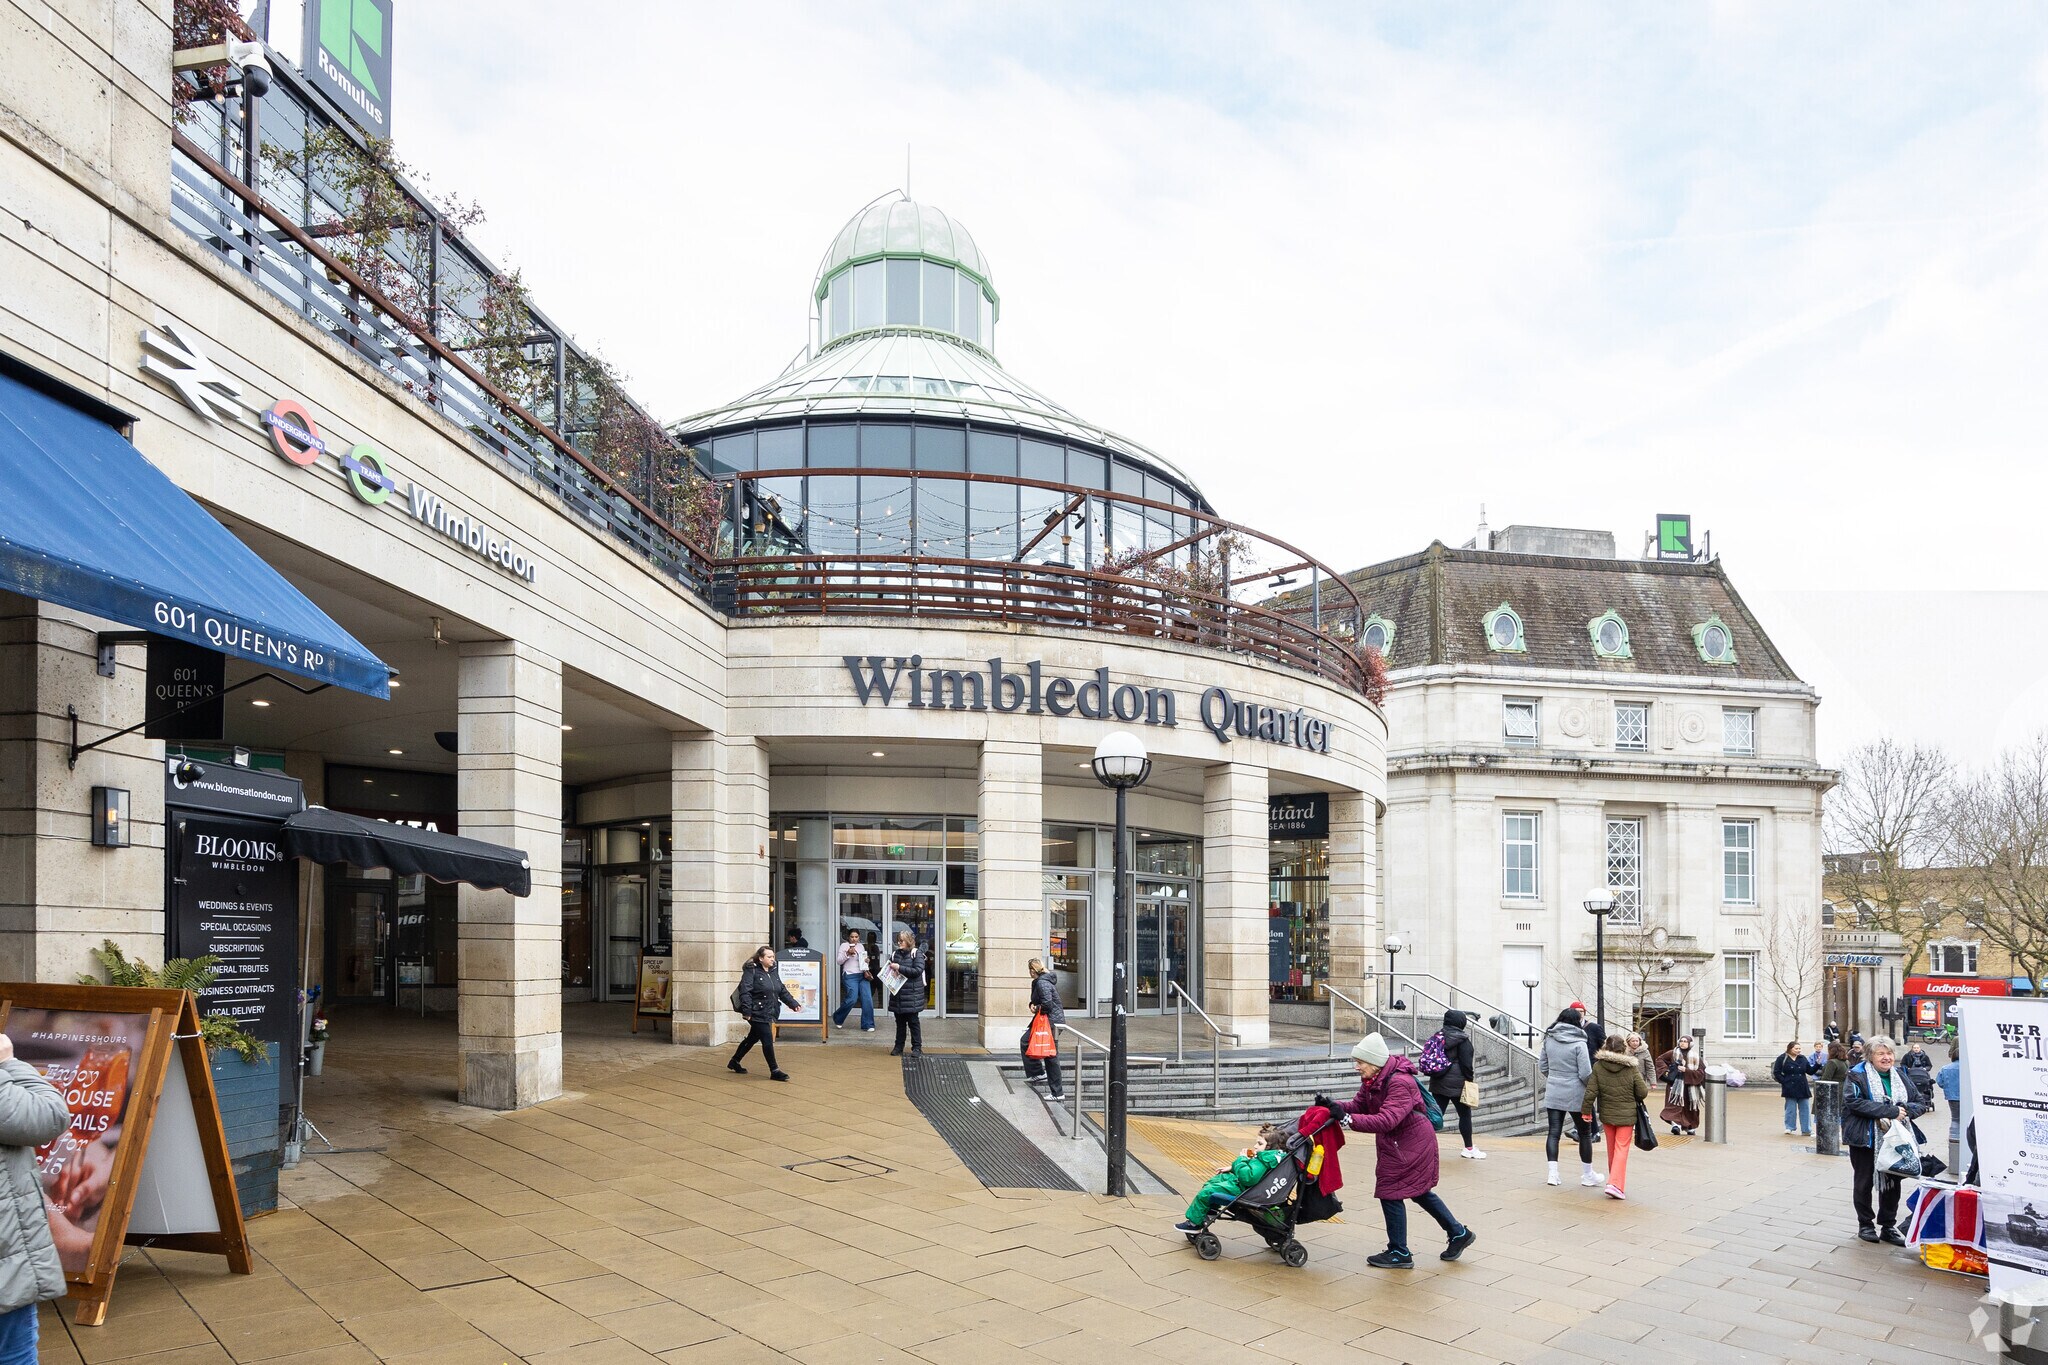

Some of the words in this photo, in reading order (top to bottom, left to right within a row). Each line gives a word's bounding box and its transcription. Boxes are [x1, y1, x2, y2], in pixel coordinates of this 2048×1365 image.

[319, 47, 382, 124] Romulus
[269, 415, 323, 449] UNDERGROUND
[360, 465, 381, 483] TRAMS
[409, 483, 536, 583] Wimbledon
[154, 601, 196, 633] 601
[204, 618, 297, 664] QUEEN'S
[174, 668, 197, 681] 601
[156, 684, 214, 700] QUEEN'S
[843, 654, 1178, 726] Wimbledon
[1201, 685, 1335, 753] Quarter
[192, 780, 293, 803] www.bloomsatlondon.com
[1287, 821, 1306, 830] 1886
[195, 834, 276, 861] BLOOMS
[212, 861, 265, 872] WIMBLEDON
[198, 901, 237, 910] WEDDINGS
[246, 903, 273, 912] EVENTS
[200, 923, 231, 931] SPECIAL
[233, 924, 271, 932] OCCASIONS
[209, 944, 264, 952] SUBSCRIPTIONS
[1827, 953, 1884, 966] express
[198, 987, 234, 996] BUSINESS
[235, 984, 275, 995] CONTRACTS
[1926, 983, 1980, 994] Ladbrokes
[207, 1008, 230, 1016] LOCAL
[232, 1005, 266, 1016] DELIVERY
[1996, 1023, 2024, 1035] WE
[2028, 1025, 2041, 1036] R
[31, 1032, 127, 1044] #HAPPINESSHOURS
[45, 1064, 100, 1088] Enjoy
[1984, 1096, 2027, 1108] Supporting
[49, 1132, 89, 1156] for
